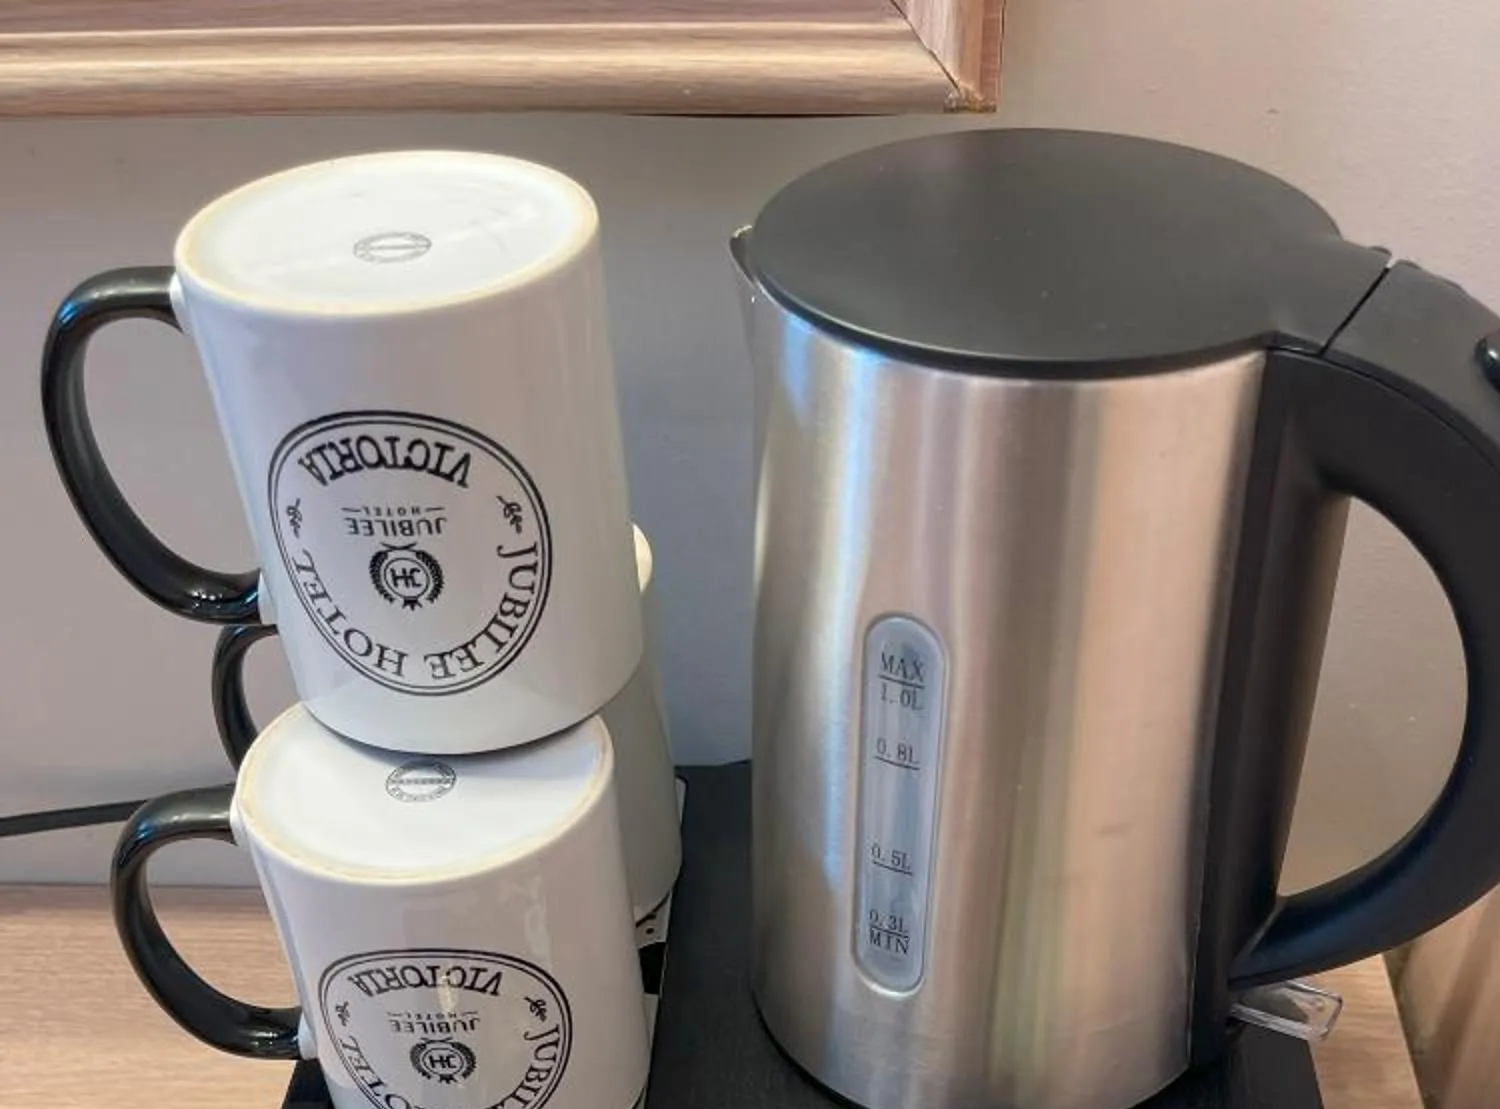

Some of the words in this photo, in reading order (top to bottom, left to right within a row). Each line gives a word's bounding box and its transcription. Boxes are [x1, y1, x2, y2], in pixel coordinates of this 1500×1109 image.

[297, 434, 472, 489] VICTORIA
[361, 505, 423, 516] HOTEL
[348, 517, 448, 537] JUBILEE
[292, 548, 410, 679] HOTEL
[423, 541, 540, 681] JUBILEE
[880, 651, 926, 683] MAX
[869, 928, 911, 955] MIN
[347, 964, 503, 998] VICTORIA
[389, 1018, 482, 1034] JUBILEE
